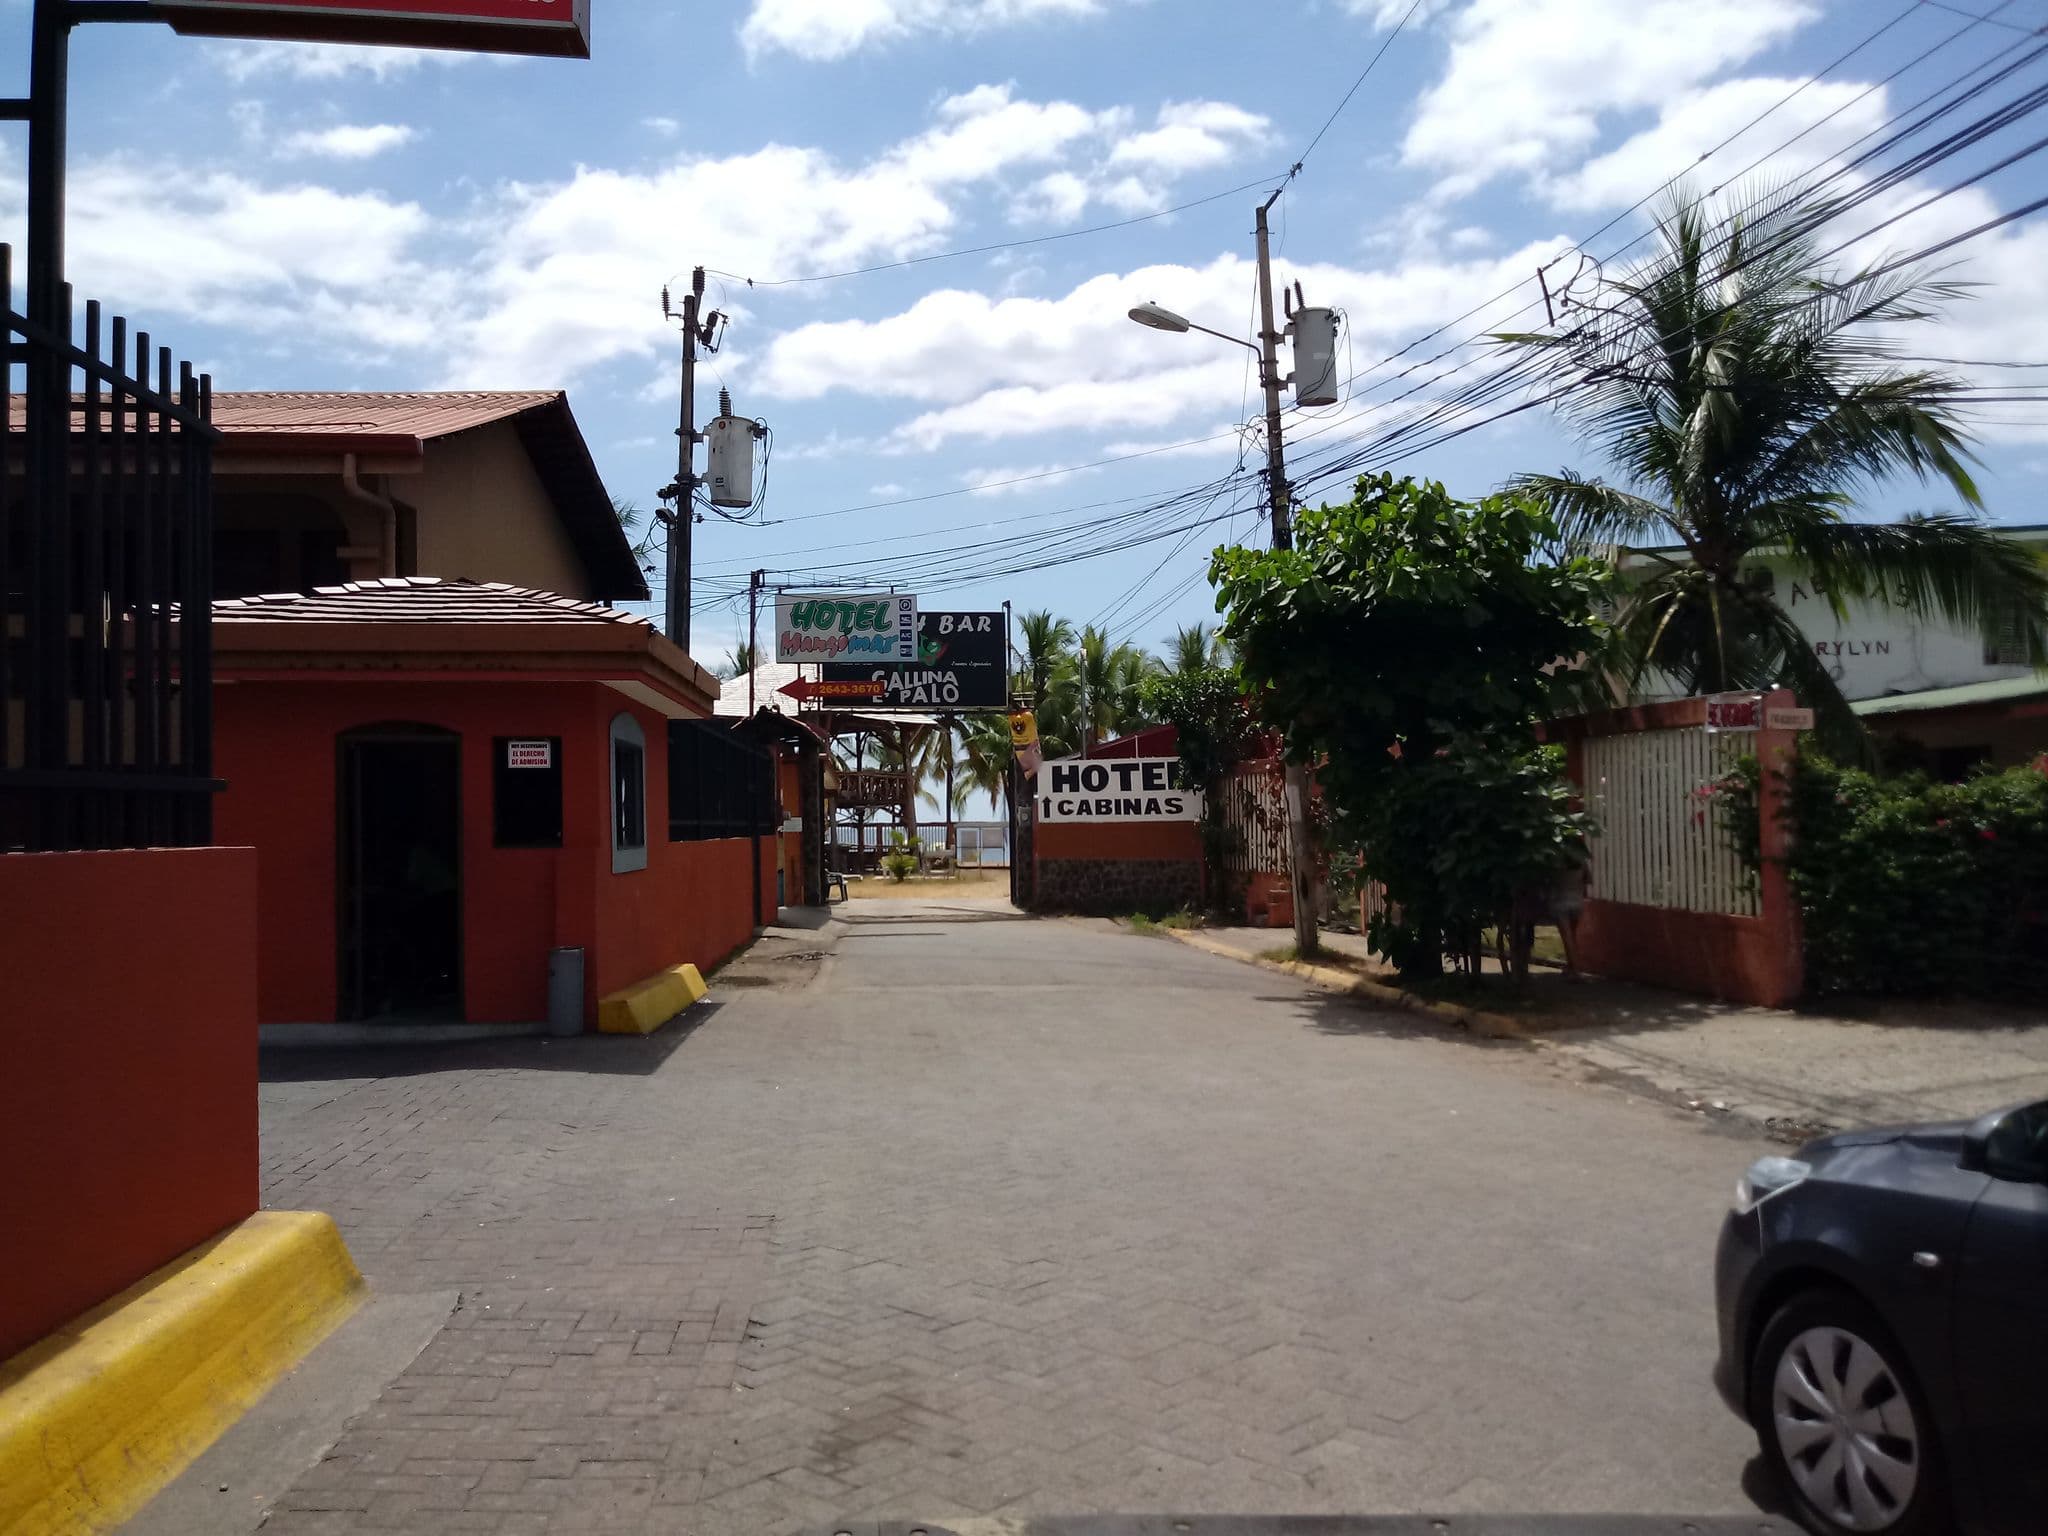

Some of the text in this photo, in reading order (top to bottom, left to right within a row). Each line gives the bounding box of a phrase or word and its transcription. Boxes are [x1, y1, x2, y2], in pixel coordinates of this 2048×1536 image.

[790, 600, 892, 635] HOTEL
[939, 615, 991, 634] BAR
[1815, 640, 1889, 656] RYLYN
[819, 684, 880, 694] 2643-3670
[872, 670, 959, 692] GALLINA
[900, 683, 960, 703] PALO
[1057, 797, 1184, 816] CABINAS
